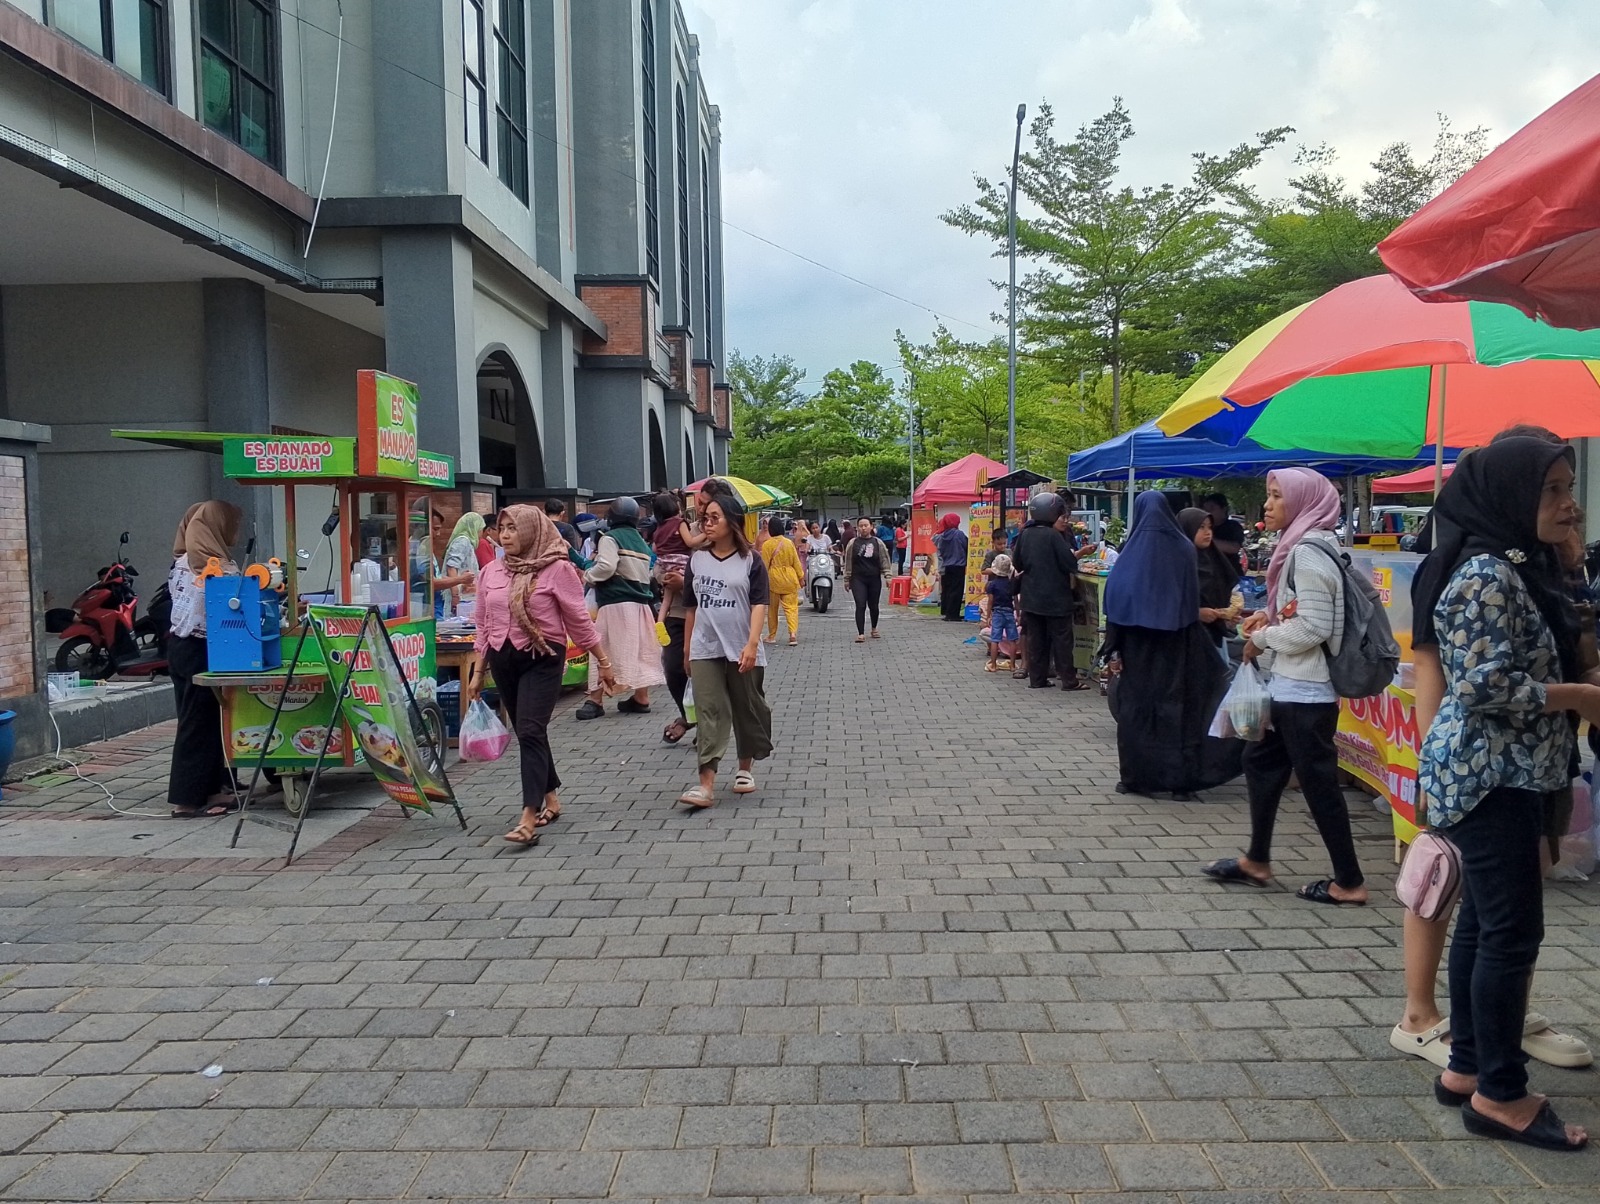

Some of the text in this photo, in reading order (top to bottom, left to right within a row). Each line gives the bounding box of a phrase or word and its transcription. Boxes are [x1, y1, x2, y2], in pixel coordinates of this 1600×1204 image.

[391, 393, 404, 424] ES
[244, 441, 332, 457] ES MANADO
[380, 428, 416, 463] MANADO
[256, 457, 321, 472] ES BUAH
[419, 458, 449, 480] ES BUAH
[700, 575, 728, 588] Mrs.
[700, 594, 736, 608] Right
[325, 617, 340, 637] ES
